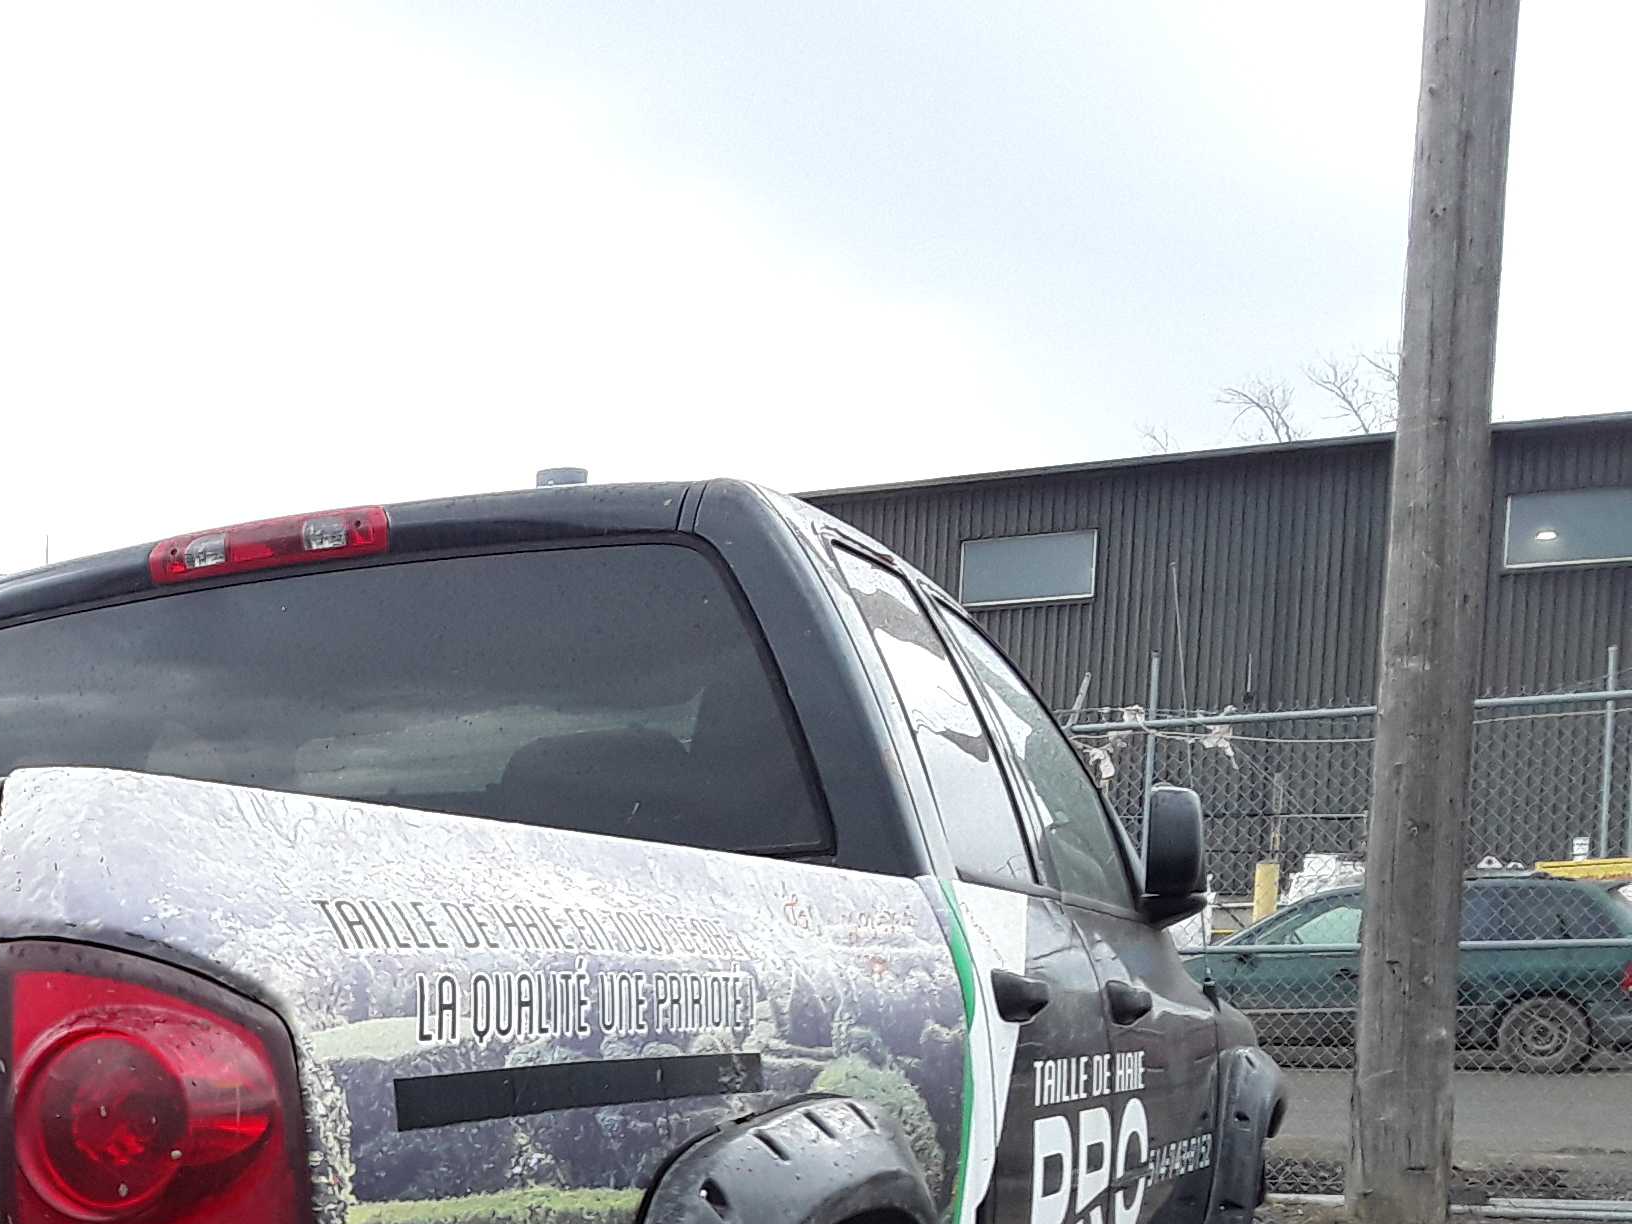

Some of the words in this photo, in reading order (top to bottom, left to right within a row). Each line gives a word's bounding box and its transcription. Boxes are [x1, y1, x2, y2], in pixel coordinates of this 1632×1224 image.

[312, 899, 449, 949] TAILLE
[440, 902, 499, 949] DE
[490, 903, 574, 950] HAIE
[417, 973, 460, 1041] LA
[472, 957, 590, 1042] QUALITÉ
[598, 972, 649, 1033] UNE
[1033, 1055, 1088, 1106] TAILLE
[1092, 1053, 1111, 1096] DE
[1116, 1051, 1145, 1092] HAIE
